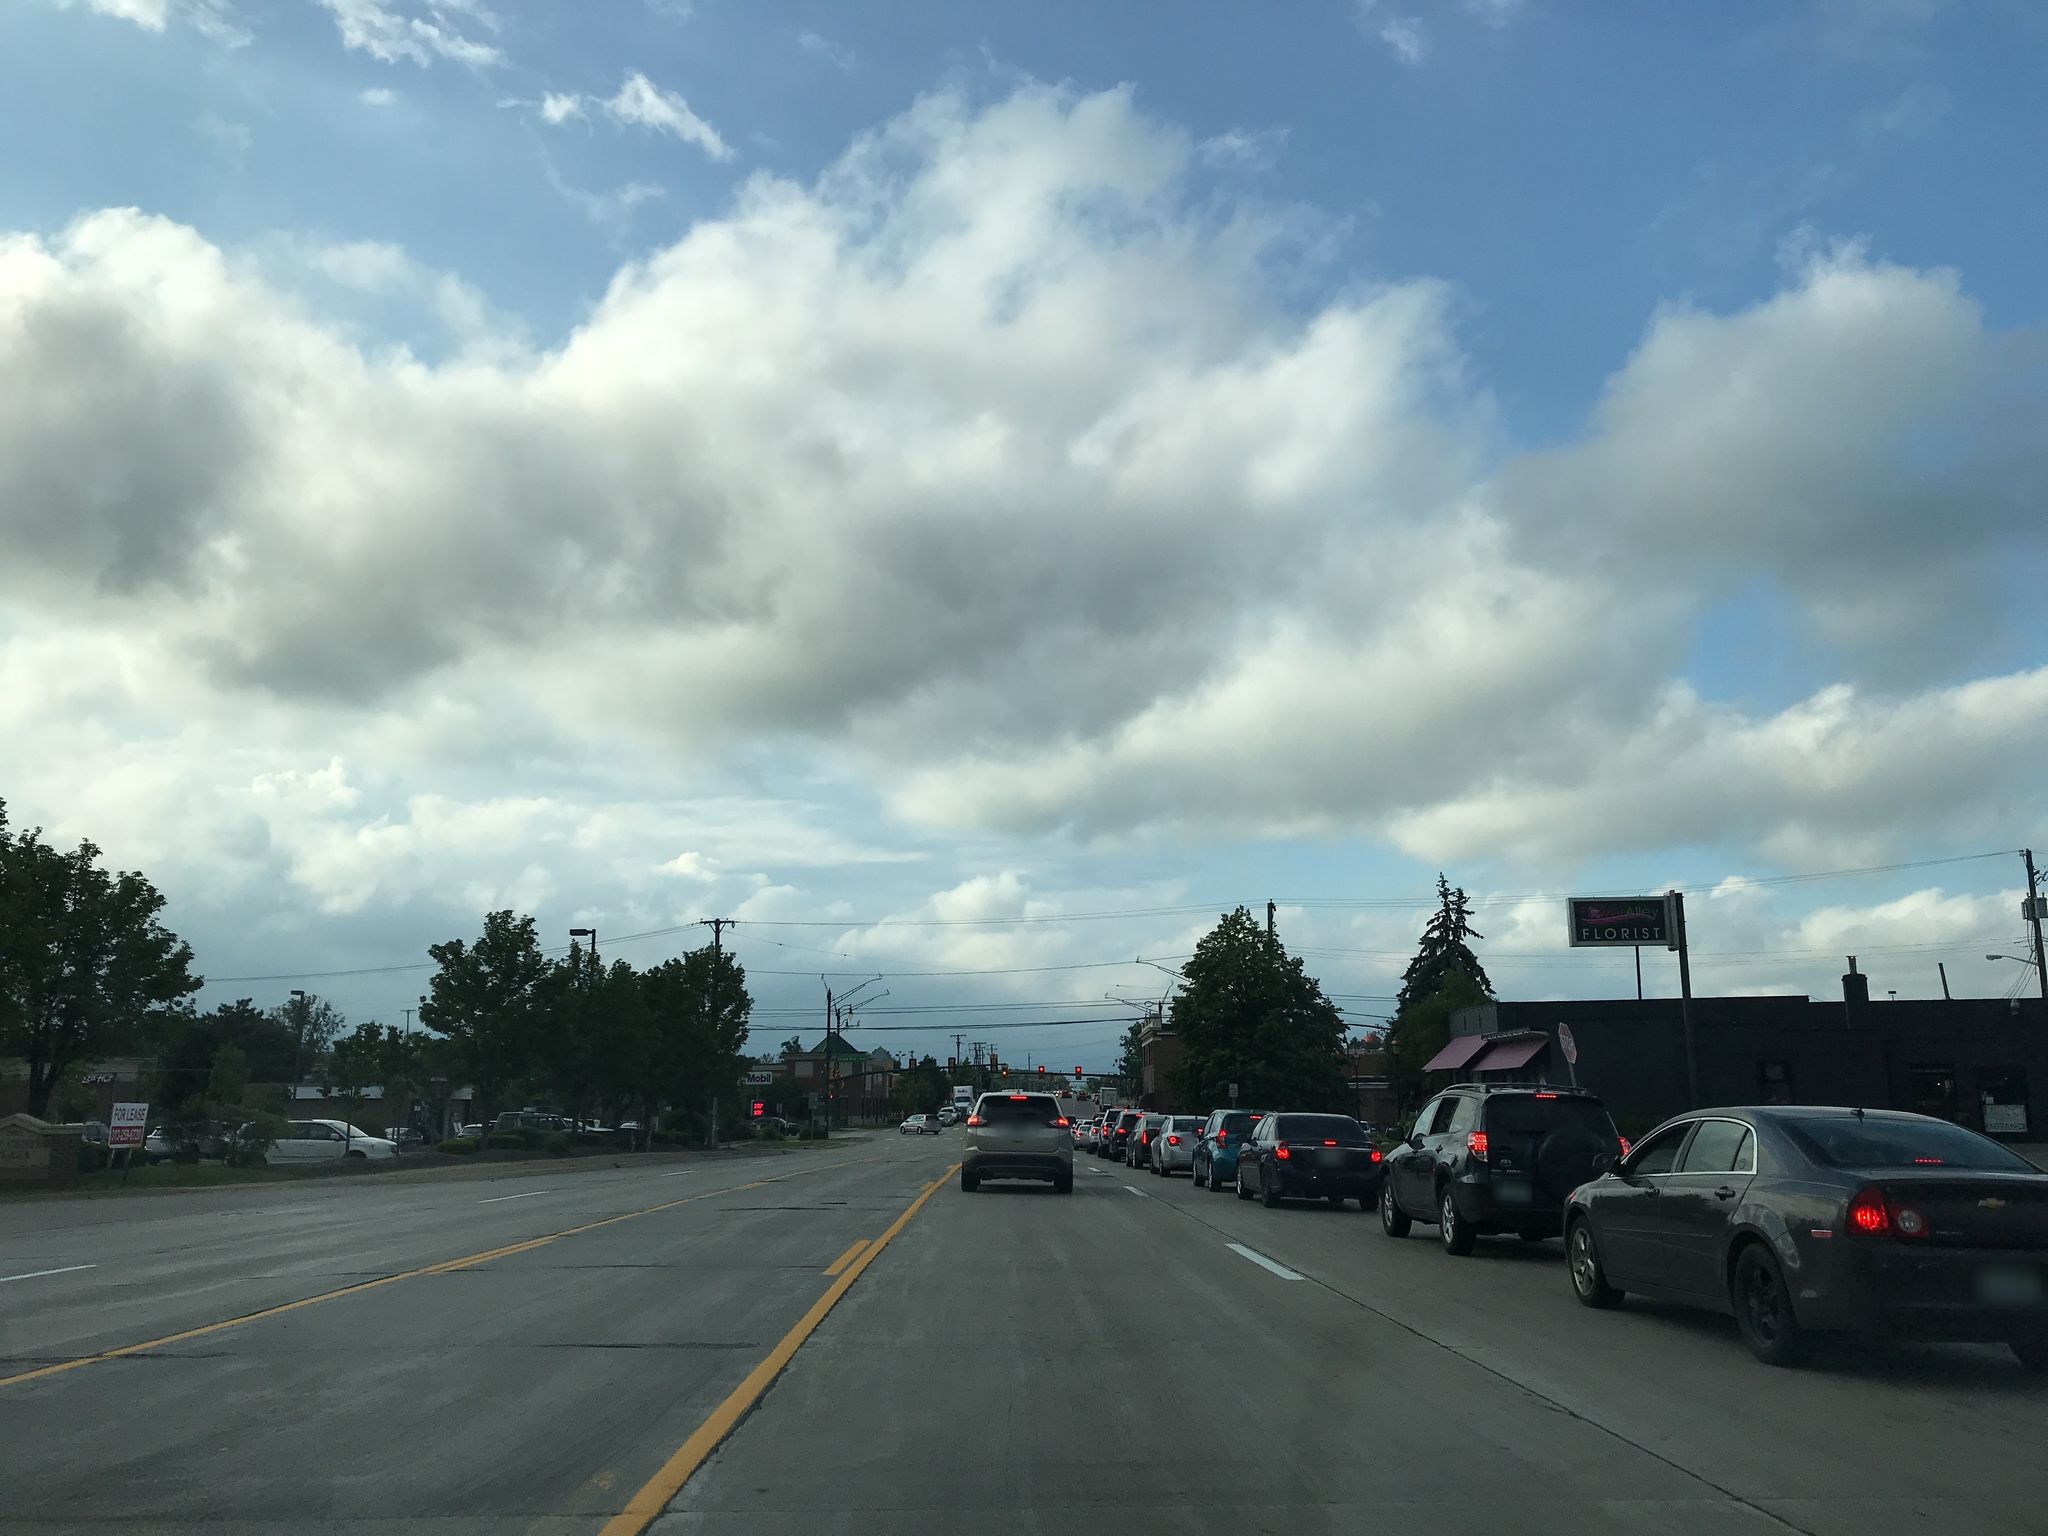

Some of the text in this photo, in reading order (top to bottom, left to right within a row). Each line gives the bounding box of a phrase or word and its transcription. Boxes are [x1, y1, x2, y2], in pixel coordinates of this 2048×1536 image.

[1582, 928, 1660, 940] FLORIST
[747, 1074, 771, 1083] Mobil
[113, 1107, 146, 1121] FOR LEASE
